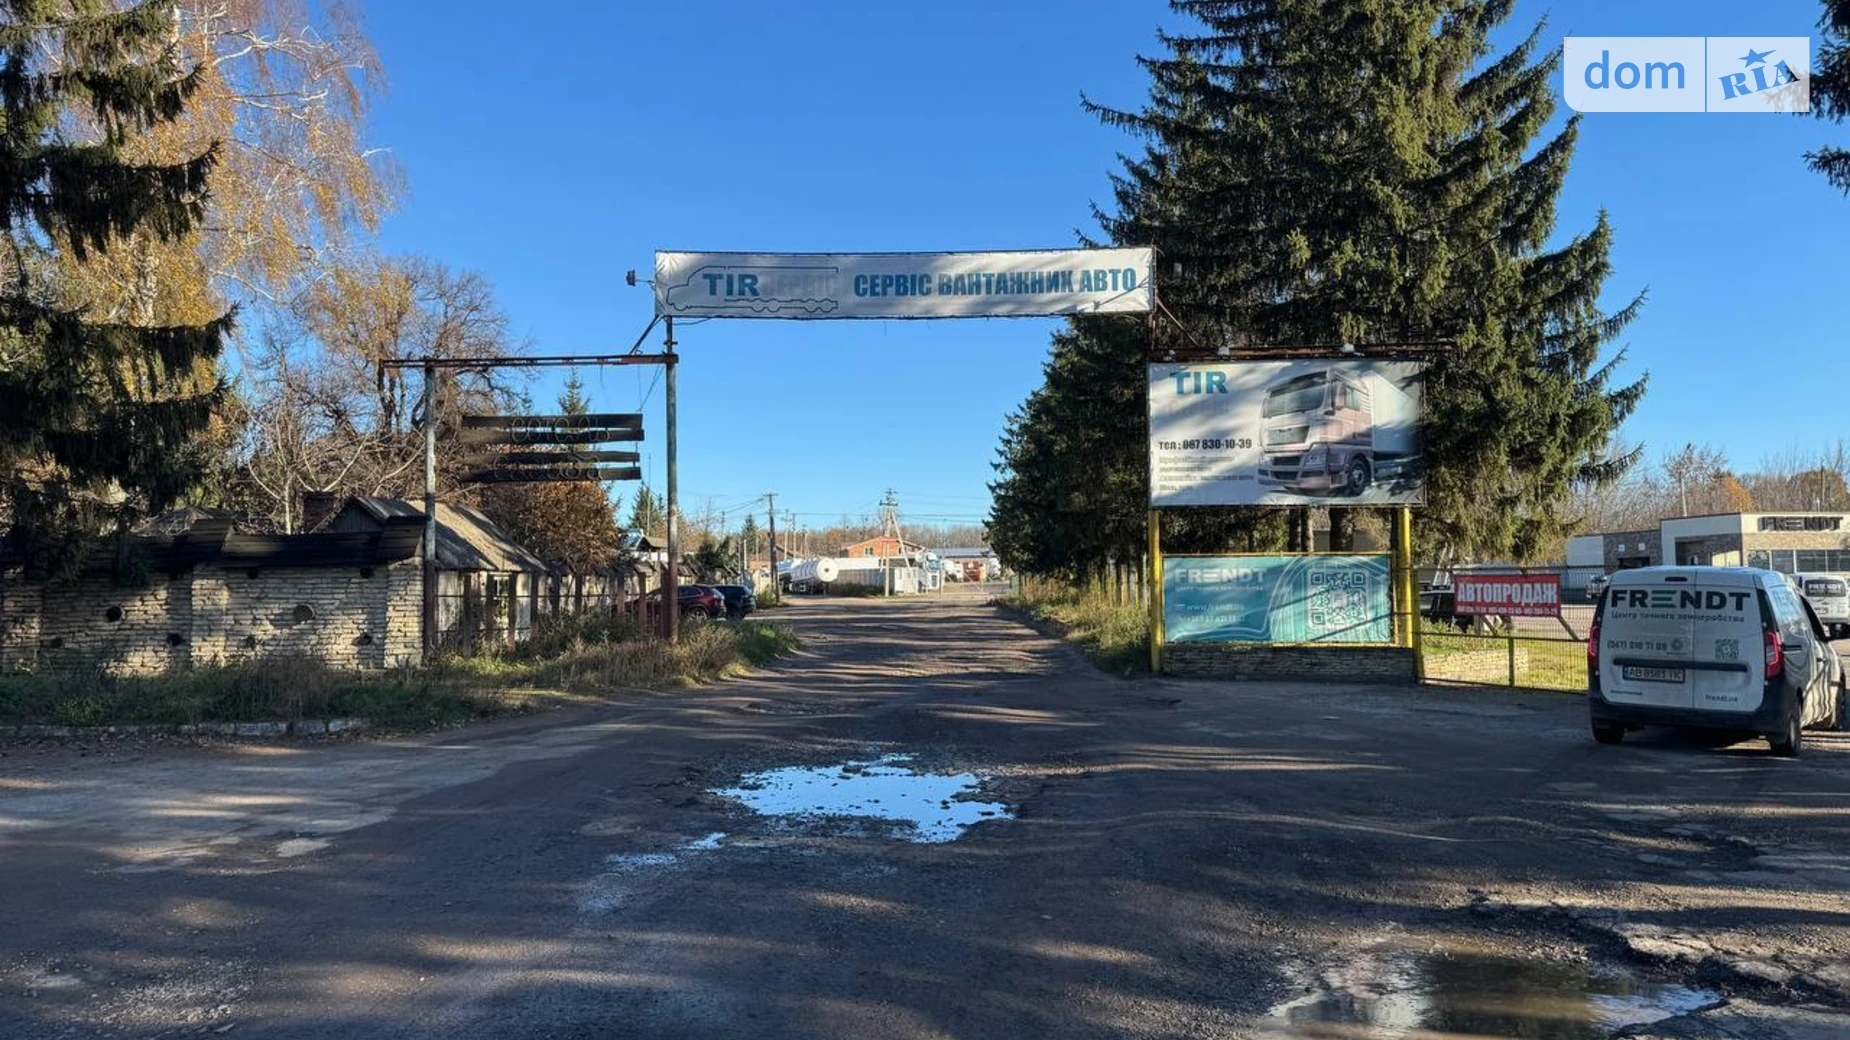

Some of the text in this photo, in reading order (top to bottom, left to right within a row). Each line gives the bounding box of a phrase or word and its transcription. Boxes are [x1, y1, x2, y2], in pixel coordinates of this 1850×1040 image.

[702, 273, 760, 296] TIR
[854, 267, 1136, 297] СЕРВІС ВАНТАЖНИК АВТО
[1169, 371, 1228, 394] TIR
[1174, 567, 1267, 584] FRENDT
[1457, 582, 1558, 606] АВТОПРОДАЖ
[1611, 589, 1751, 612] FRENDT
